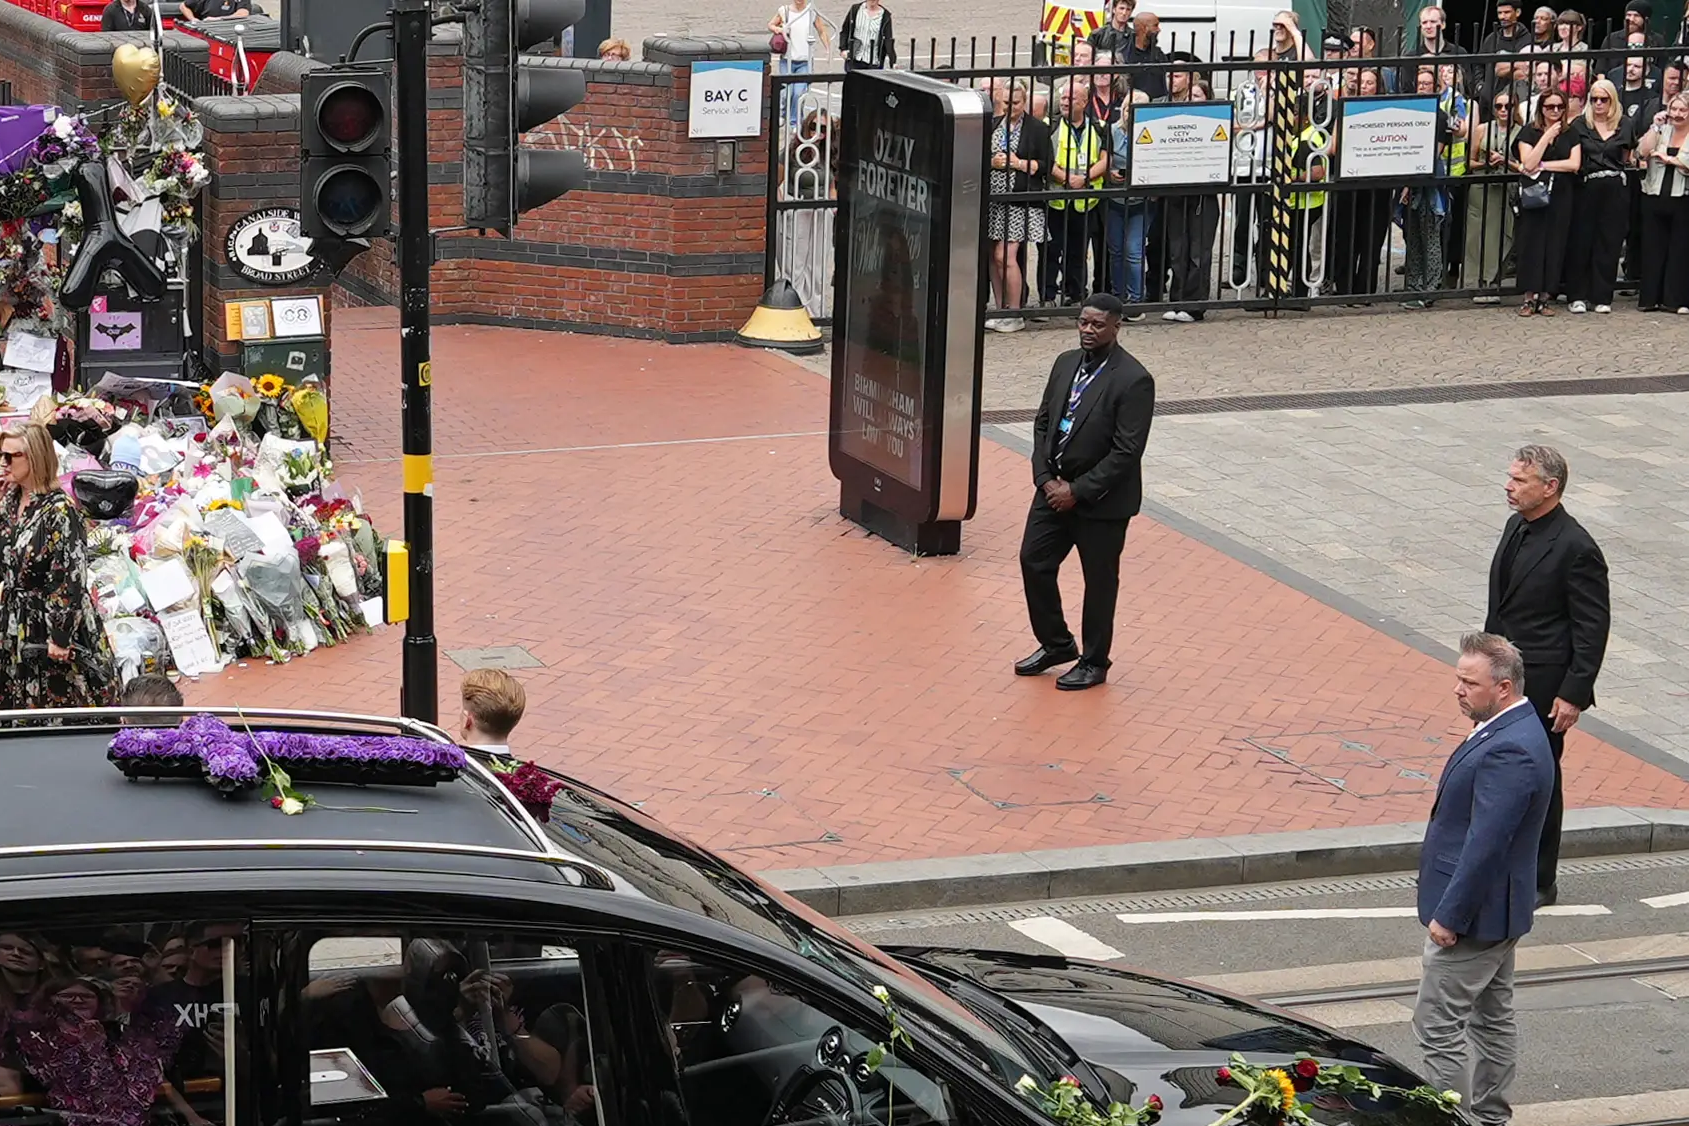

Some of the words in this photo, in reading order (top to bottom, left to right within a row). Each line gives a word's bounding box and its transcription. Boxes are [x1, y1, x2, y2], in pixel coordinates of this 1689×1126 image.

[82, 14, 103, 22] GENE
[704, 89, 733, 103] BAY
[738, 88, 748, 102] C
[702, 106, 729, 115] Service
[732, 105, 749, 114] Yard
[873, 127, 915, 171] OZZY
[1369, 134, 1408, 143] CAUTION
[1209, 172, 1221, 180] ICC
[857, 159, 928, 215] FOREVER
[235, 208, 290, 233] CANALSIDE
[240, 265, 273, 281] BROAD
[274, 263, 311, 281] STREET
[853, 372, 915, 418] BIRMIGHAM
[853, 394, 876, 423] WILL
[861, 421, 882, 446] LOV
[886, 433, 905, 459] YOU
